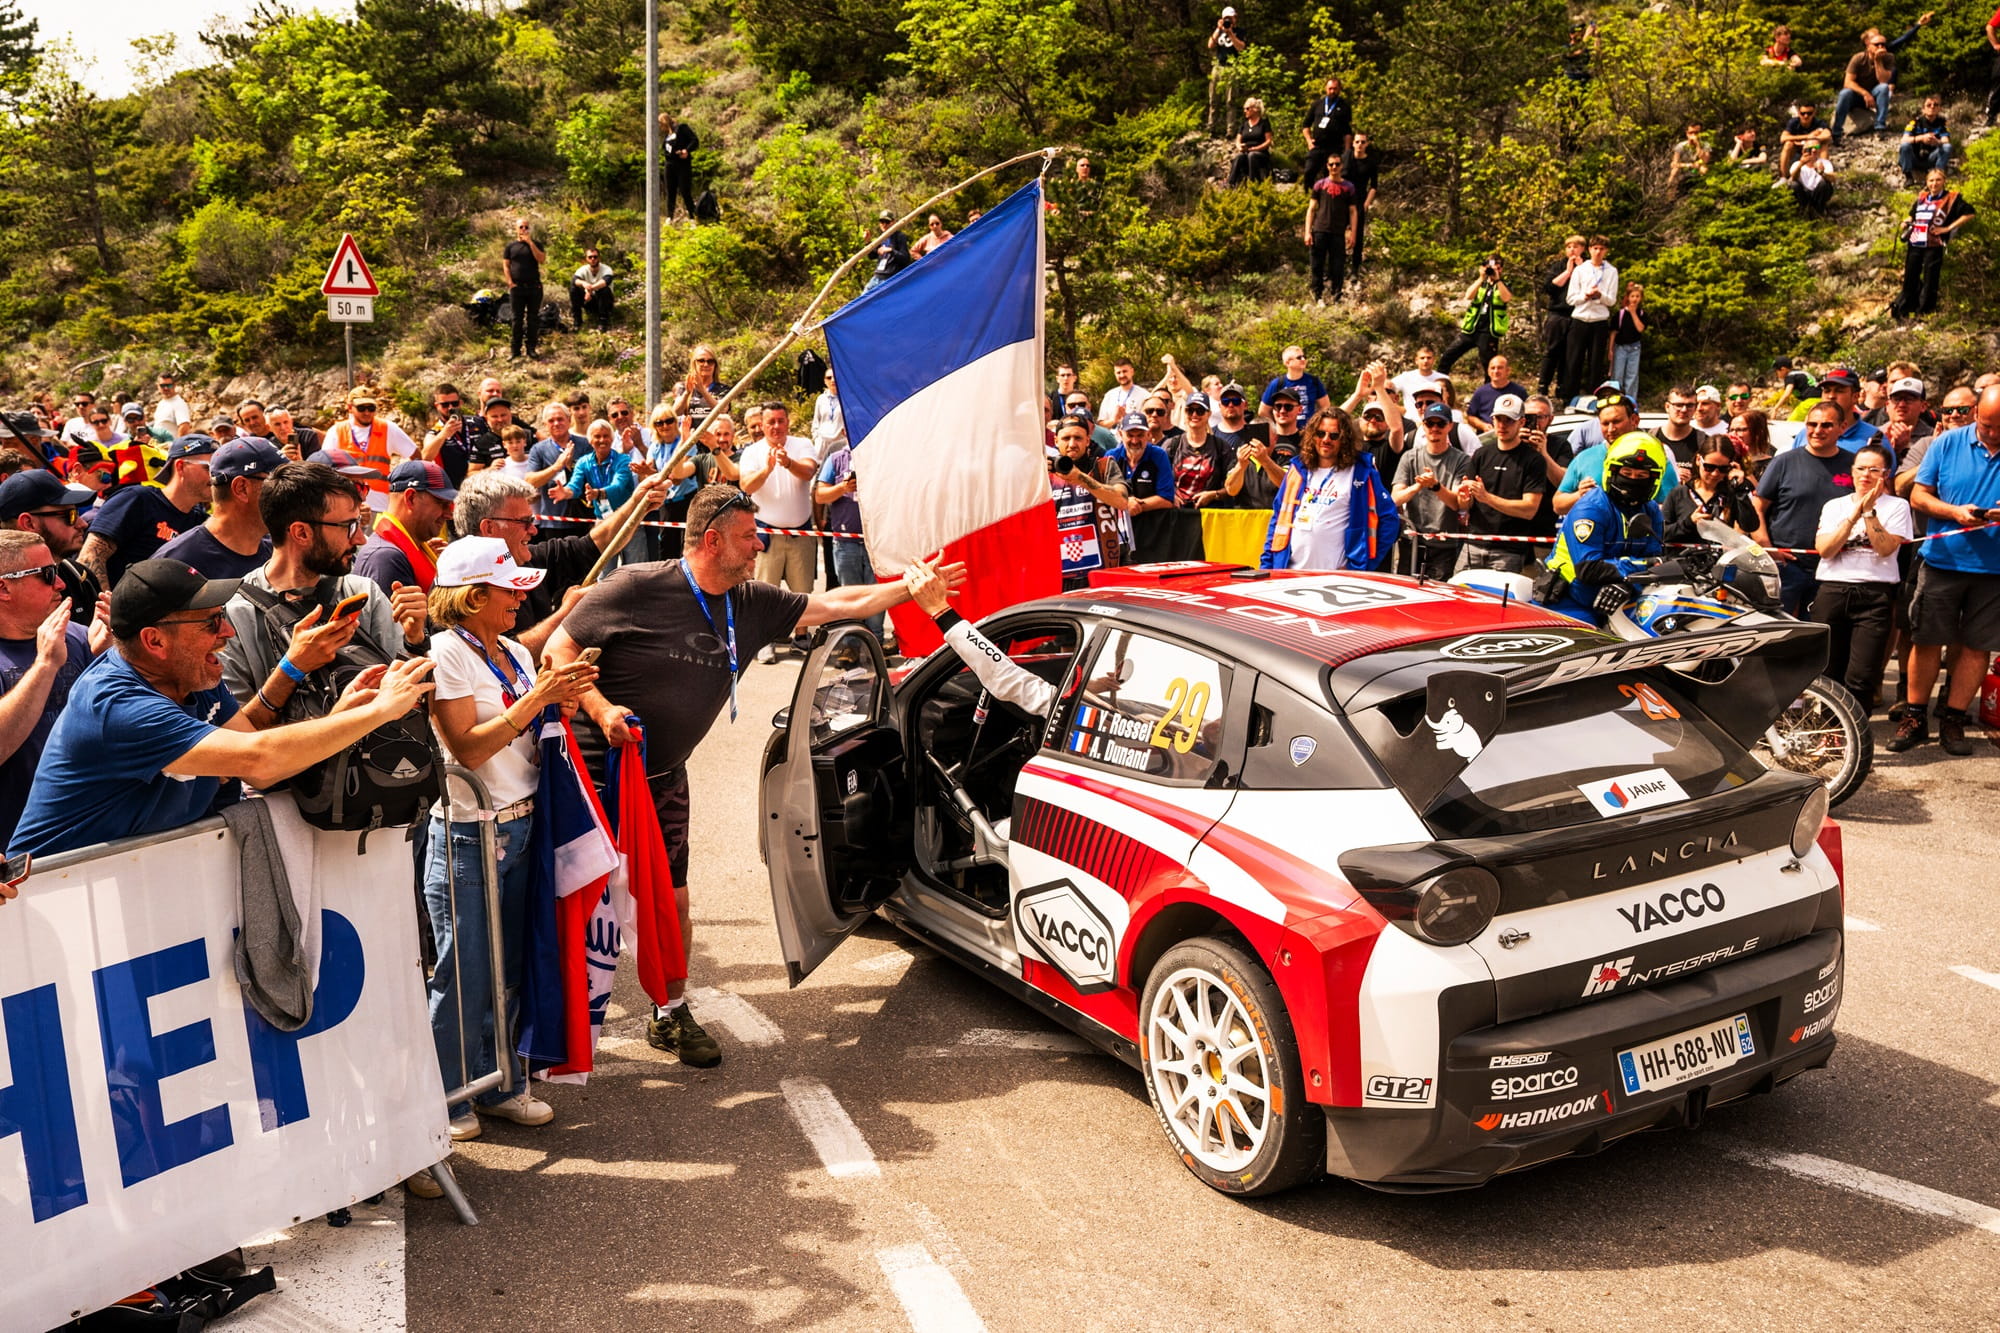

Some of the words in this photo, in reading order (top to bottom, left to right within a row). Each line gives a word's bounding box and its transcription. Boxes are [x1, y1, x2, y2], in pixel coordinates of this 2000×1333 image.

[338, 302, 351, 315] 50
[357, 305, 365, 315] m
[1284, 584, 1407, 607] 29
[966, 630, 1002, 662] YACCO
[1150, 677, 1211, 754] 29
[1617, 682, 1681, 721] 29
[1097, 710, 1108, 733] Y.
[1110, 713, 1155, 743] Rossel
[1089, 736, 1101, 759] A.
[1104, 740, 1152, 772] Dunand
[1628, 780, 1668, 799] JANAF
[1592, 831, 1739, 880] LANCIA
[1616, 883, 1726, 934] YACCO
[1030, 907, 1108, 971] YACCO
[1627, 936, 1760, 986] INTEGRALE
[1640, 1026, 1735, 1083] HH-688-NV
[1741, 1037, 1753, 1052] 52
[1366, 1075, 1432, 1100] GT2i
[1491, 1066, 1578, 1100] sparco
[1628, 1076, 1635, 1086] F
